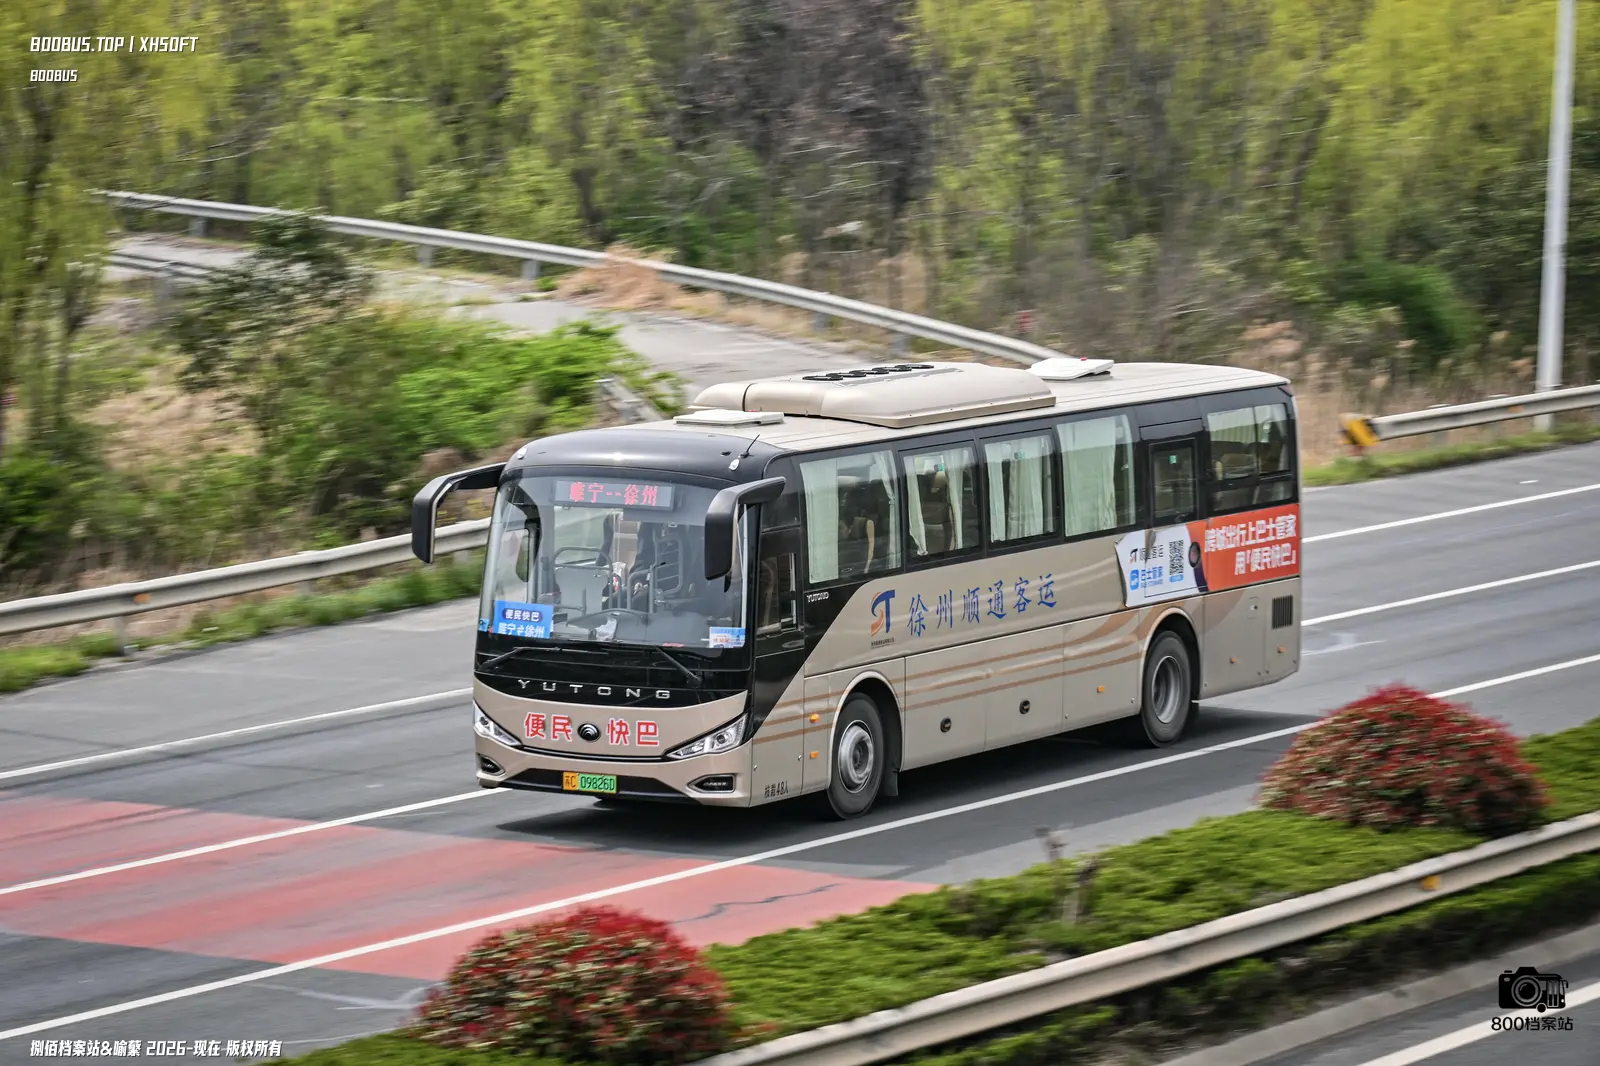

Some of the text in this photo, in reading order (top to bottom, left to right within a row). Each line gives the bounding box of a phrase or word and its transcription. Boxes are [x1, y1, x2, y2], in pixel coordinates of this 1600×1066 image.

[505, 609, 540, 622] 便民快巴
[906, 573, 1057, 638] 徐州顺通客运
[517, 679, 671, 699] YUTONG
